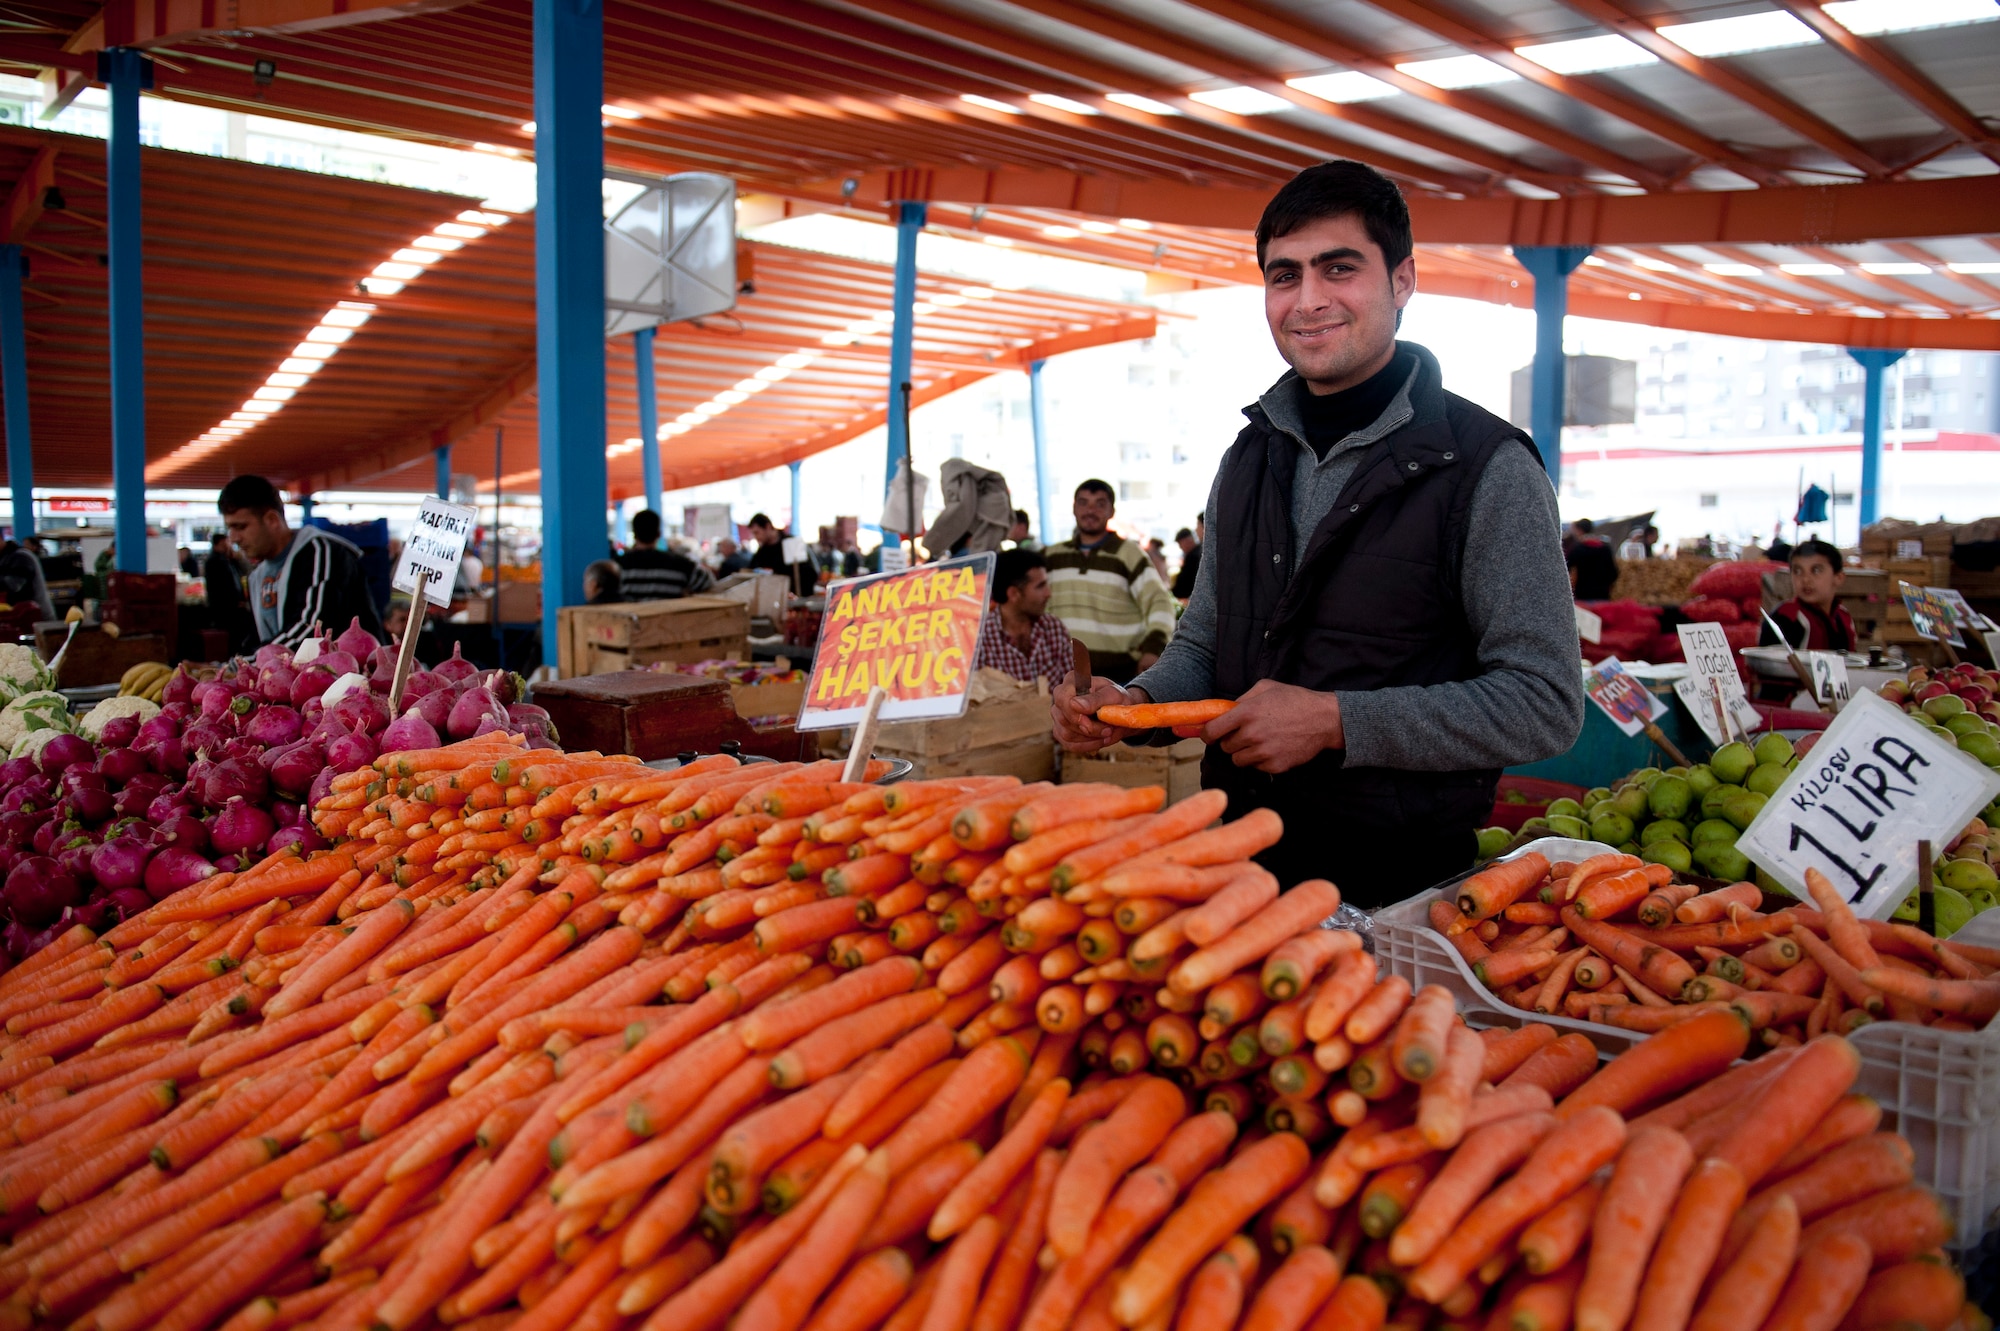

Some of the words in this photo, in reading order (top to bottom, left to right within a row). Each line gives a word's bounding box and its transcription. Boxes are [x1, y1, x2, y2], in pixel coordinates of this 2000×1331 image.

[831, 566, 977, 622] ANKARA
[838, 608, 951, 664] ŞEKER
[1685, 630, 1727, 650] TATLI
[1696, 652, 1737, 675] DOĞAL
[816, 646, 963, 701] HAVUÇ
[1595, 677, 1633, 704] TATLI
[1789, 822, 1888, 904] 1
